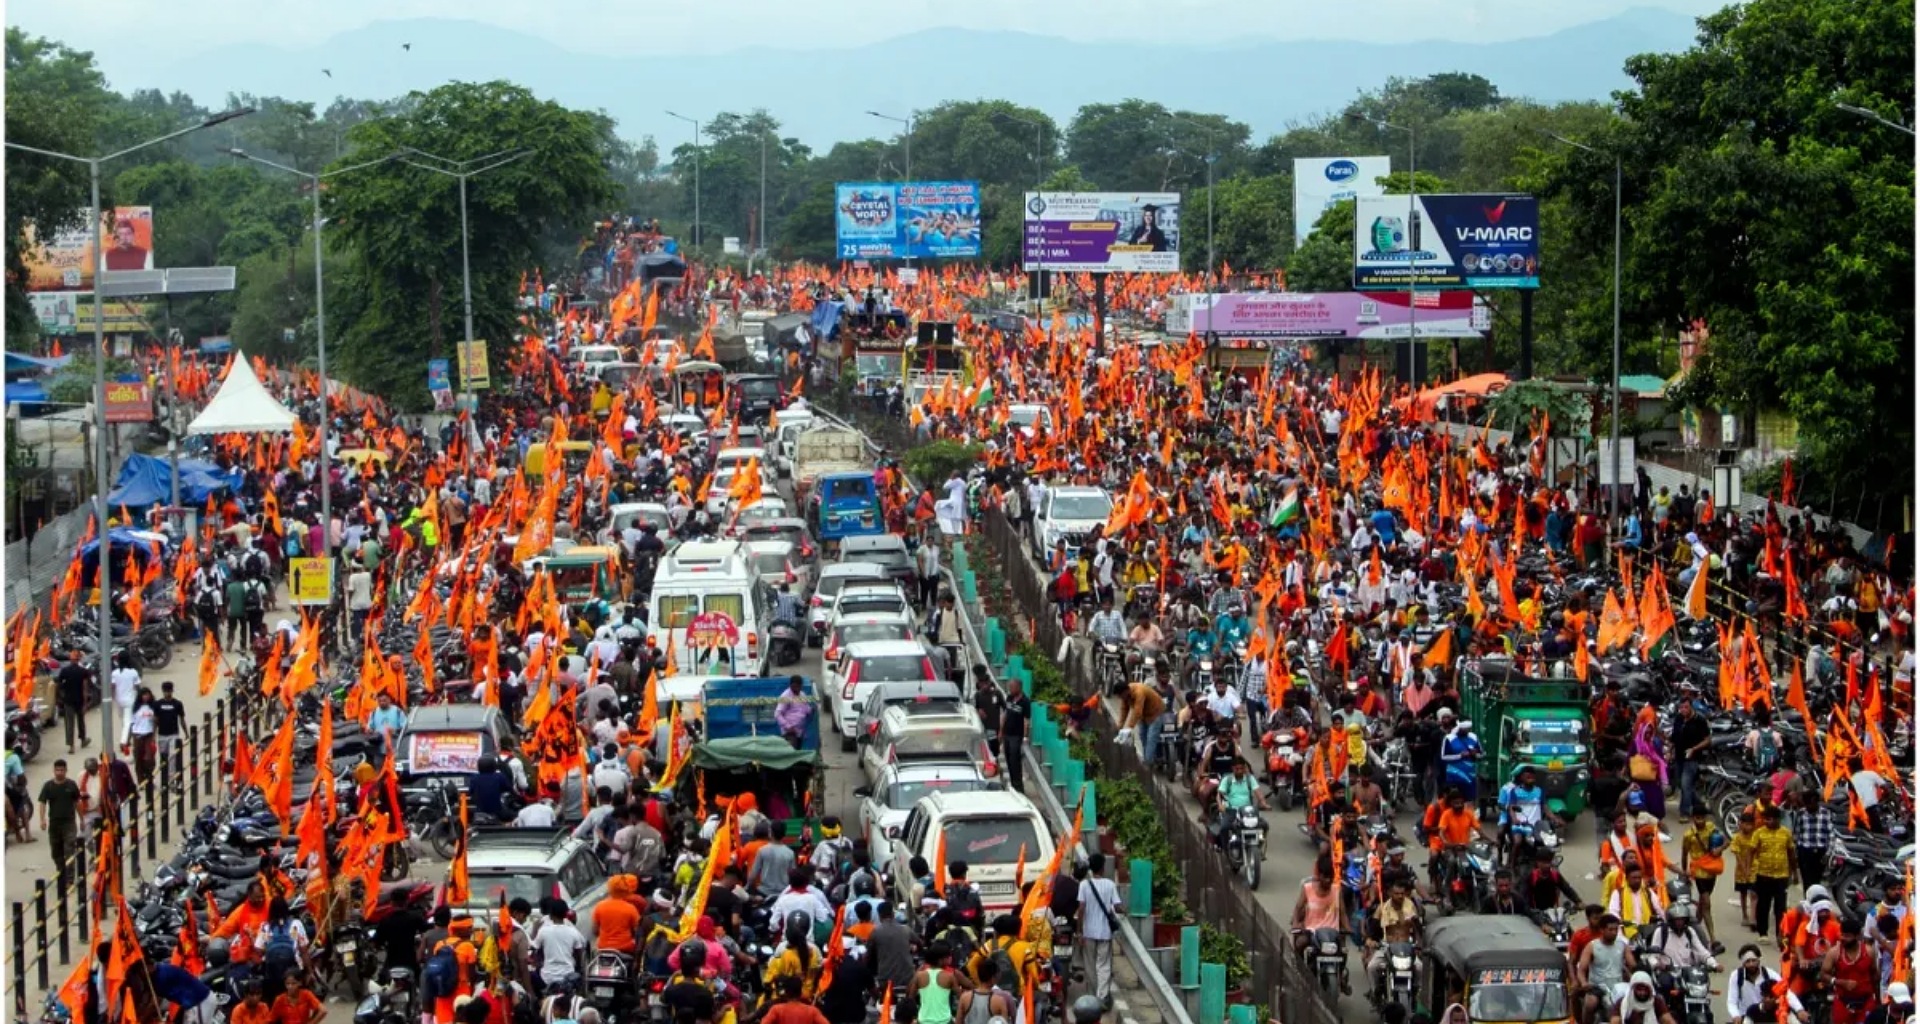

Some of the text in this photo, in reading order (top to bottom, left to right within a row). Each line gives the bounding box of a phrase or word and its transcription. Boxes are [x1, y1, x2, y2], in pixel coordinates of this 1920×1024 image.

[1329, 166, 1352, 175] Paras
[850, 201, 888, 210] CRYSTAL
[855, 211, 887, 219] WORLD
[1456, 226, 1533, 241] V-MARC
[843, 244, 857, 256] 25
[1051, 248, 1070, 257] MBA
[1271, 302, 1287, 310] और
